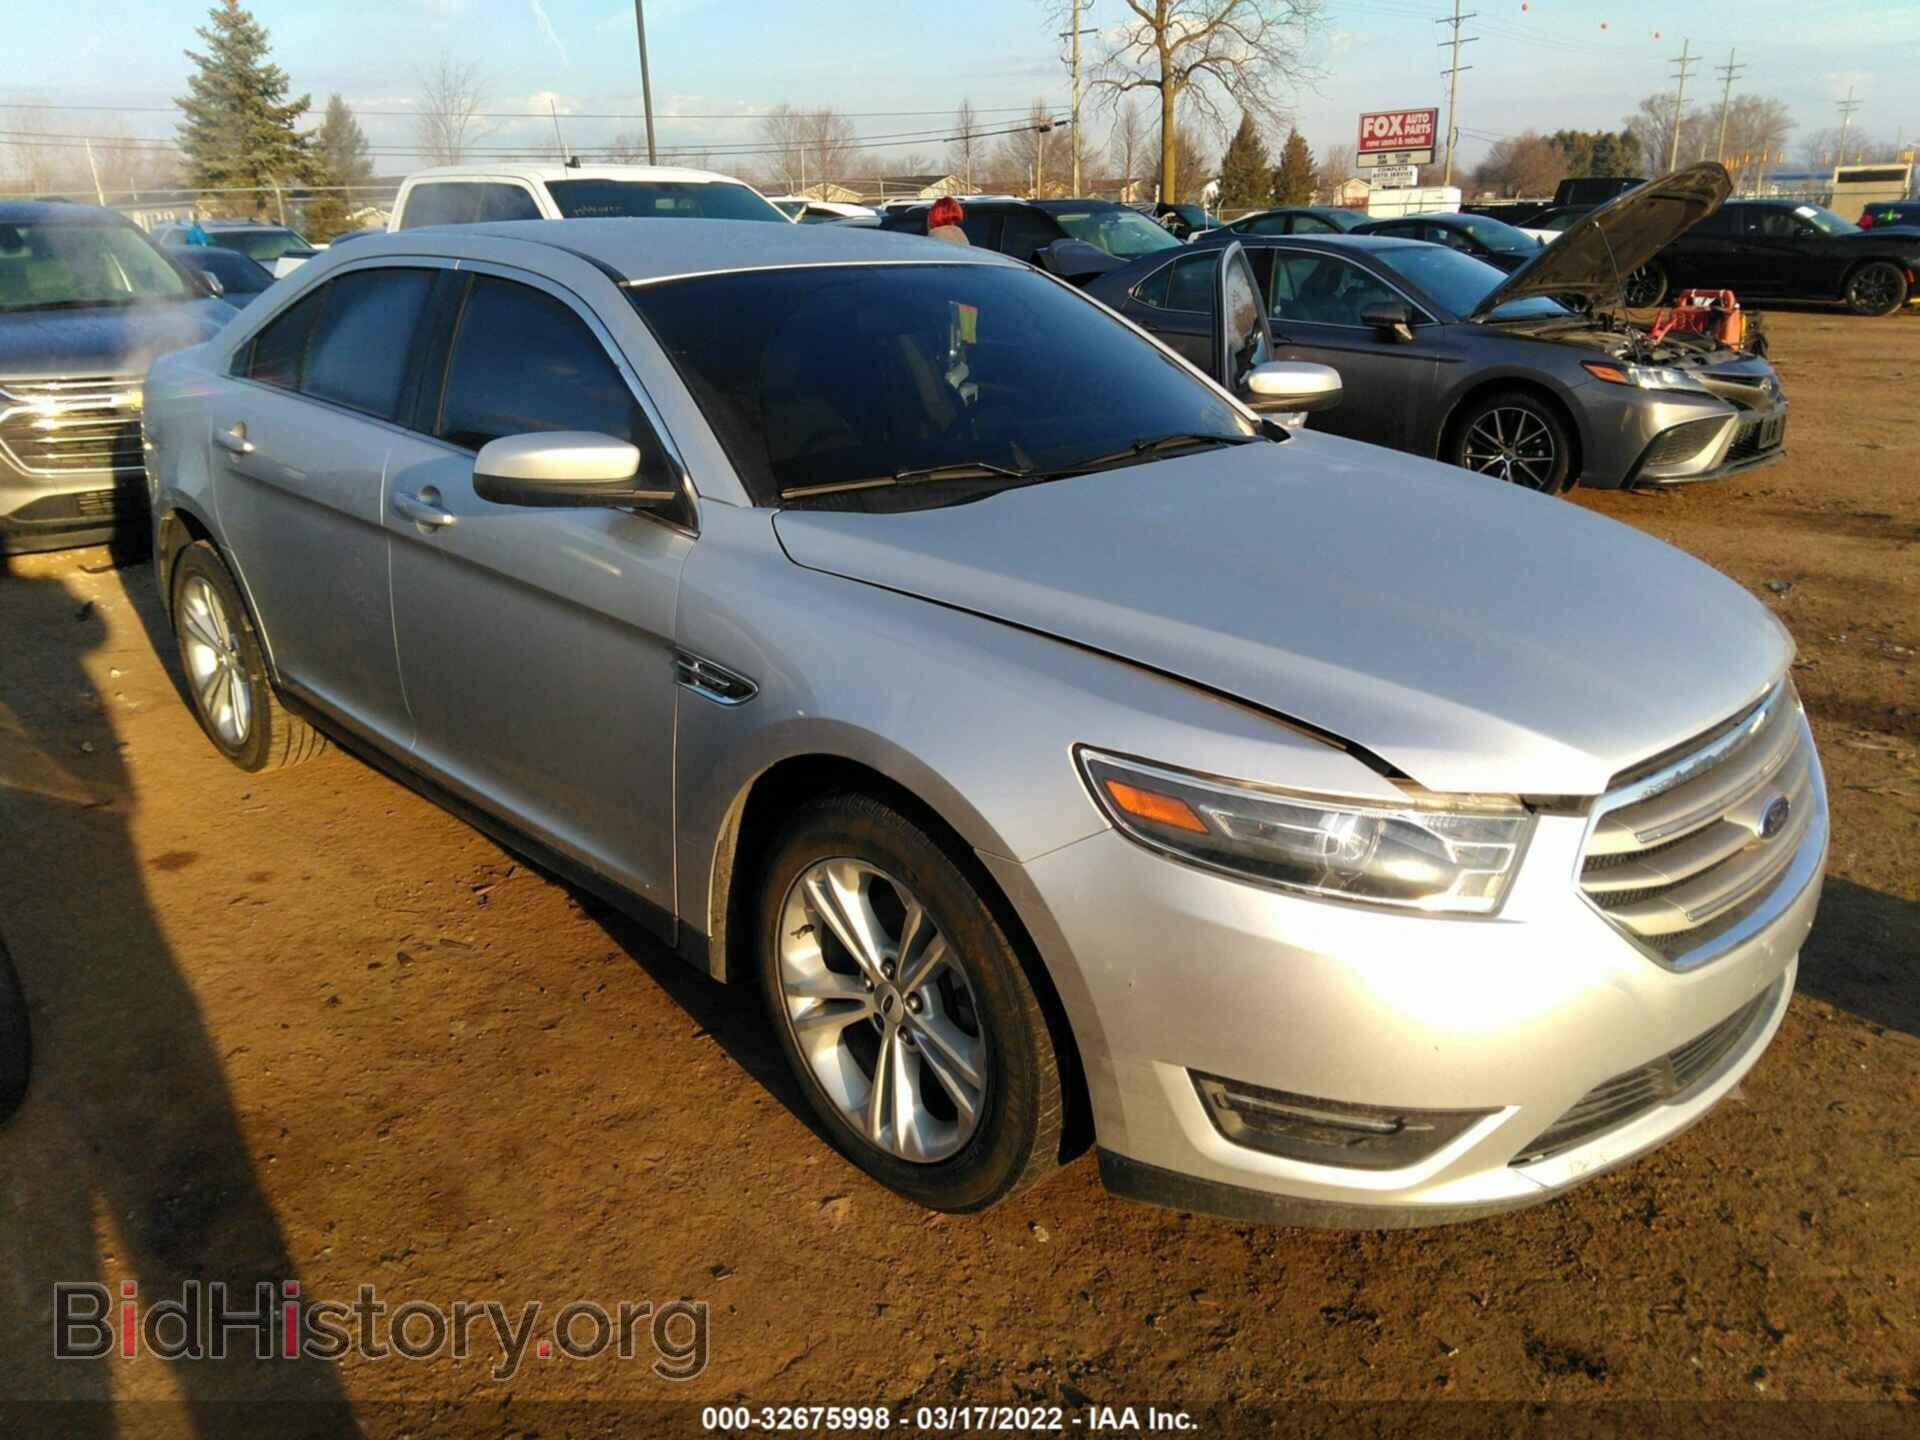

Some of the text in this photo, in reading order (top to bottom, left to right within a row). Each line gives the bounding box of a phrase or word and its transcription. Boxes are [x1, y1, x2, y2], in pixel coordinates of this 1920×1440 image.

[1407, 113, 1429, 124] AUTO
[1362, 115, 1404, 138] FOX
[1404, 123, 1431, 135] PARTS
